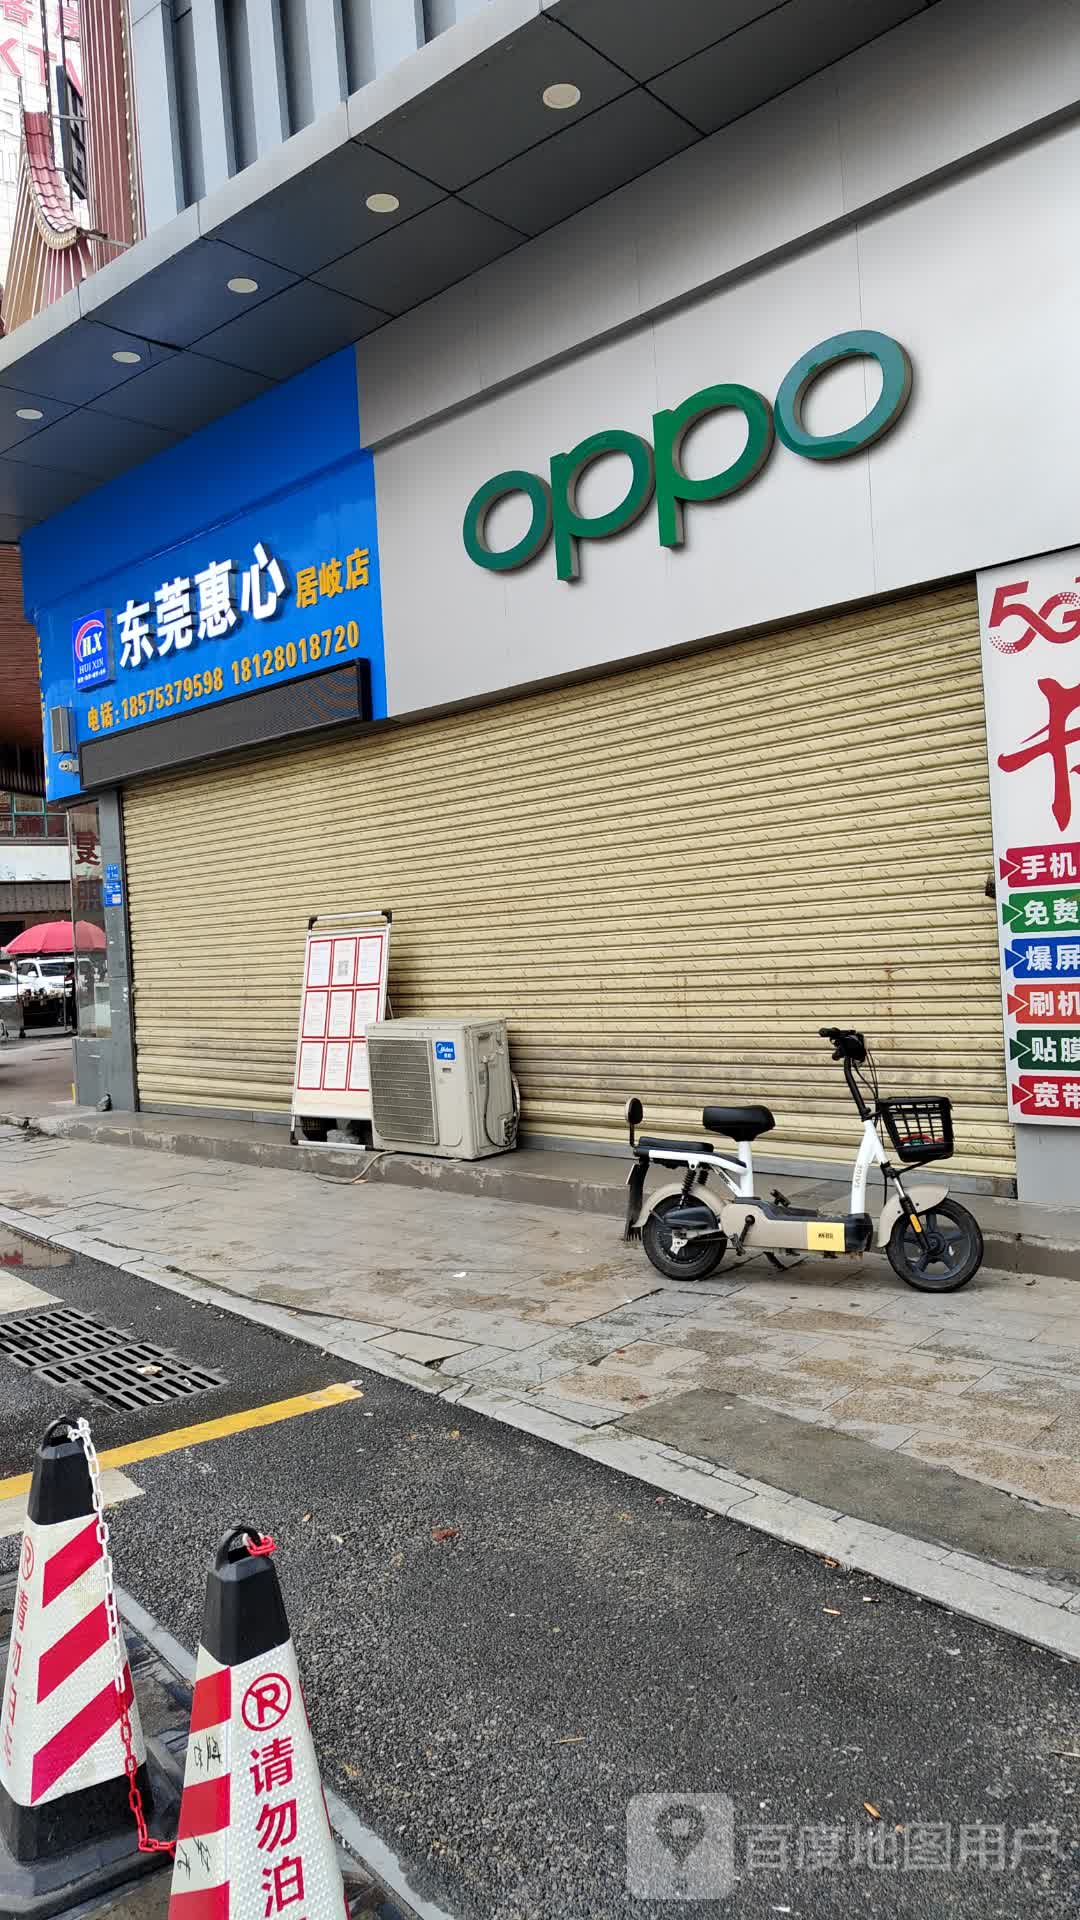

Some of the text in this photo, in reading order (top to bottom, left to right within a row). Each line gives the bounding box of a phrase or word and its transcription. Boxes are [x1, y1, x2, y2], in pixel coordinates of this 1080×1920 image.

[295, 547, 370, 608] 居岐店
[117, 542, 286, 668] 东莞惠心
[231, 621, 360, 684] 18128018720
[1020, 852, 1078, 881] 手机
[1023, 897, 1080, 927] 免费
[1025, 942, 1080, 972] 爆屏
[1029, 989, 1080, 1017] 刷机
[1031, 1036, 1080, 1063] 贴膜
[1033, 1080, 1080, 1110] 宽带
